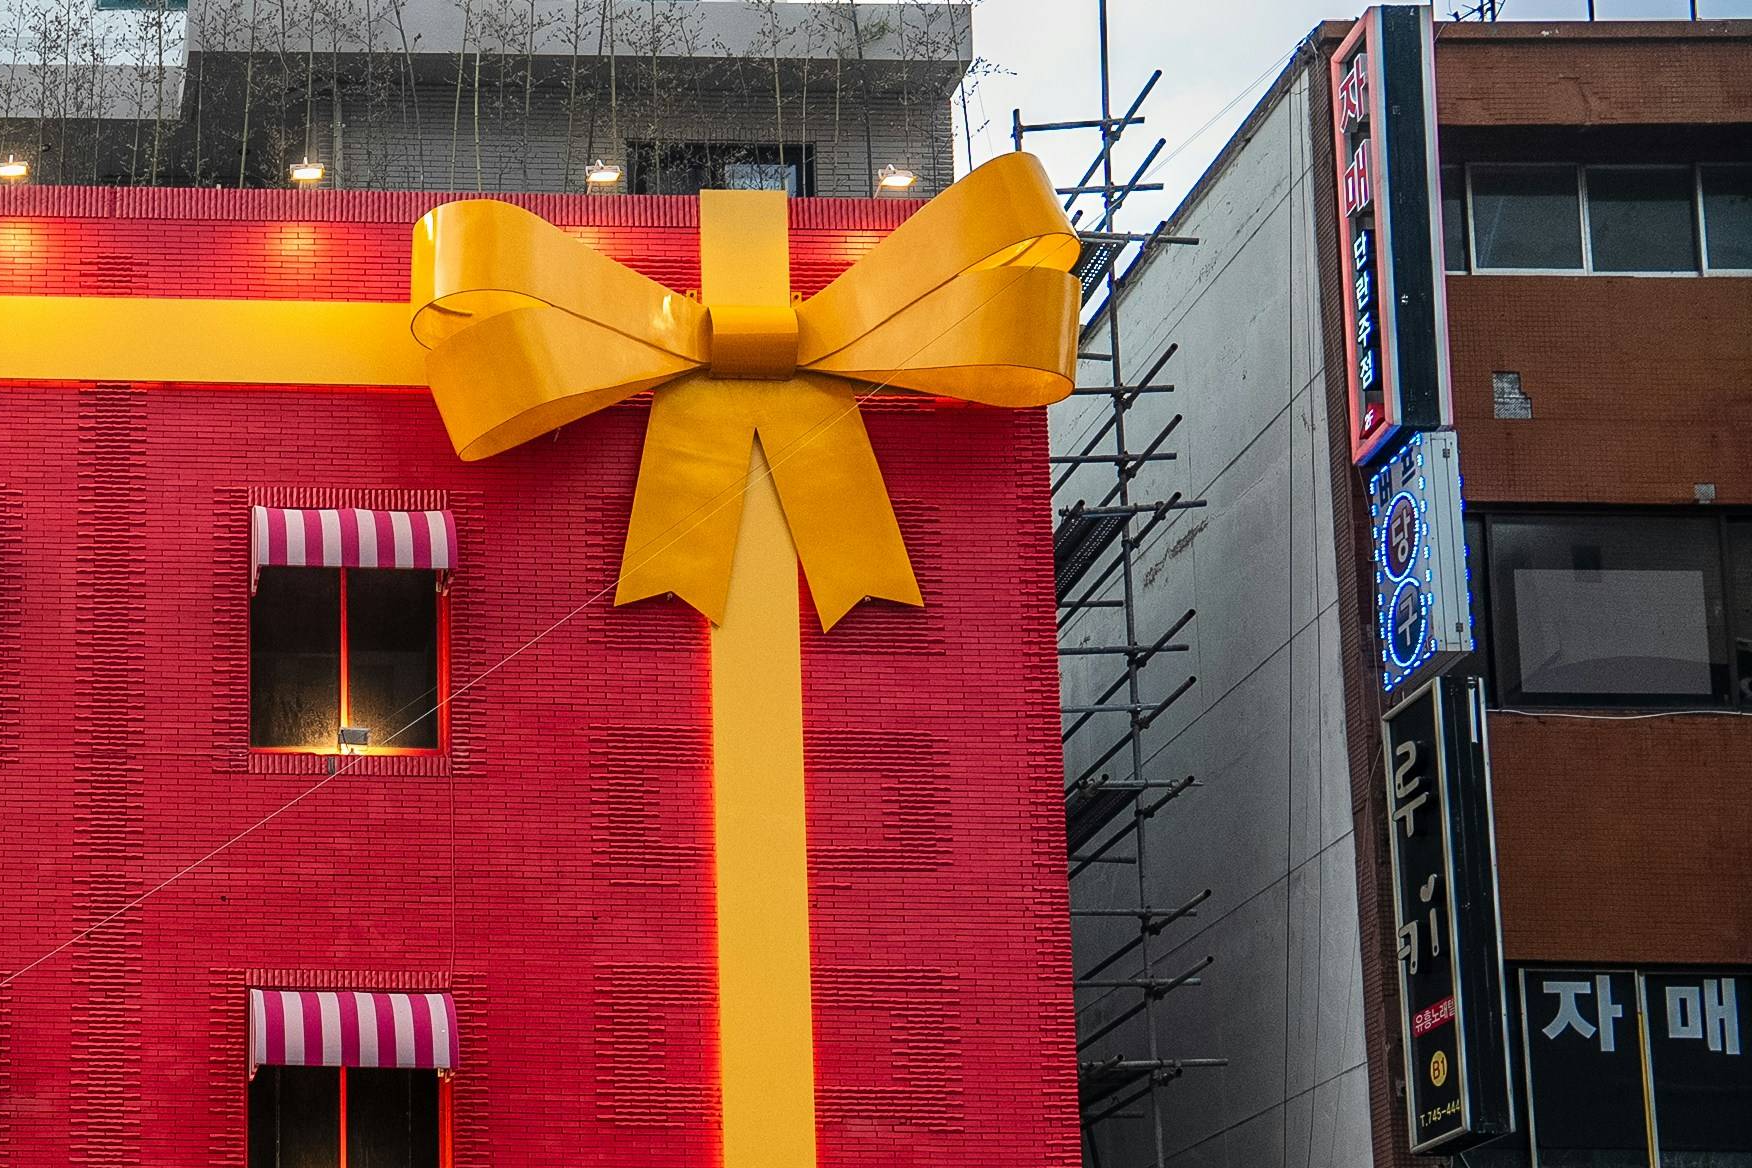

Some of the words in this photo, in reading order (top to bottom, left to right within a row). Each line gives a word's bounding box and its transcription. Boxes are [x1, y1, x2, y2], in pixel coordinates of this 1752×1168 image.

[1339, 54, 1370, 218] 자매
[1353, 231, 1374, 391] 단란주점
[1391, 507, 1417, 648] 당구
[1393, 741, 1439, 974] 루키
[1419, 1099, 1461, 1128] T.745-444
[1432, 1056, 1446, 1080] B1
